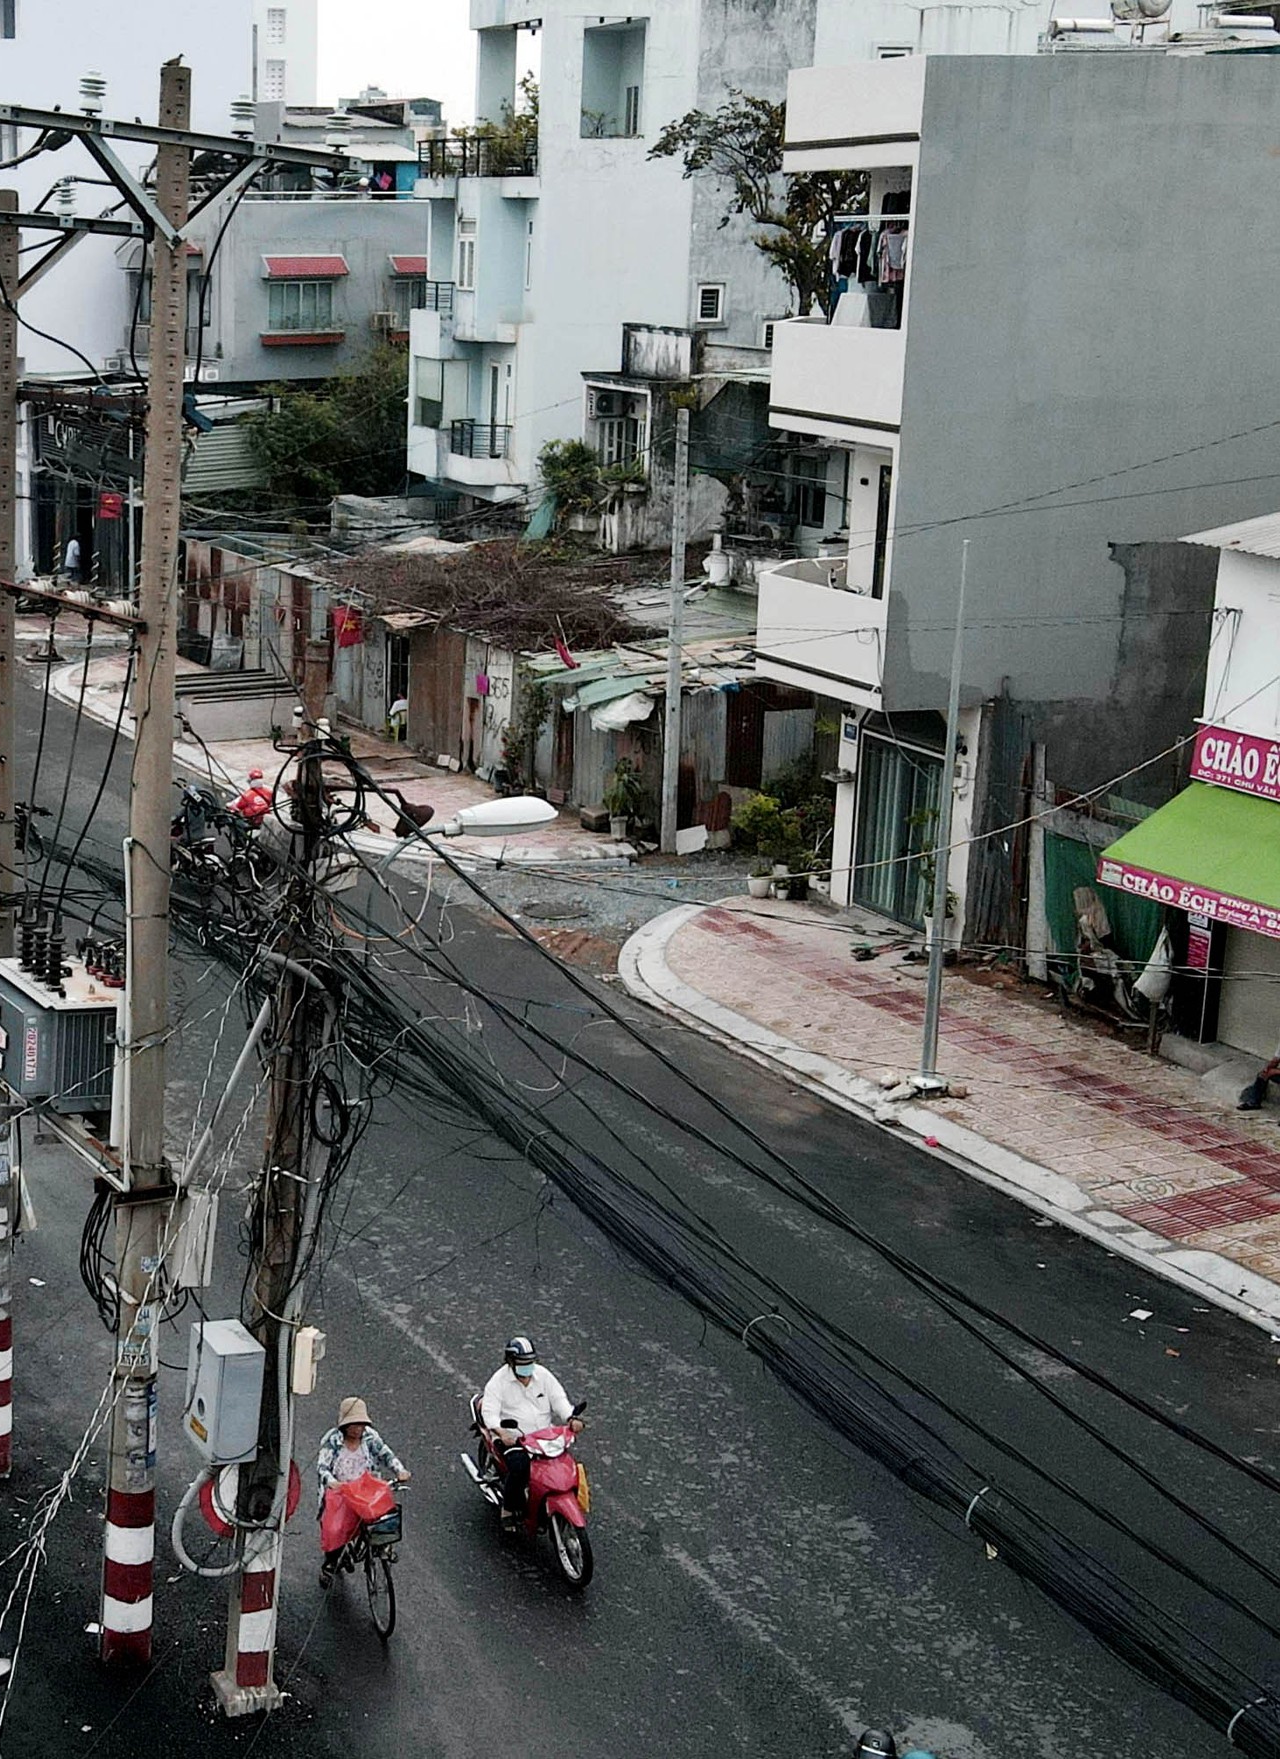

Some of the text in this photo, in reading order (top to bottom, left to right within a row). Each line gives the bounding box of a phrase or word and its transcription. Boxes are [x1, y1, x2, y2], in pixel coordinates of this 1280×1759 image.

[1201, 736, 1260, 780] CHÁO
[1122, 873, 1175, 901] CHÁO
[1178, 886, 1218, 916] ẾCH
